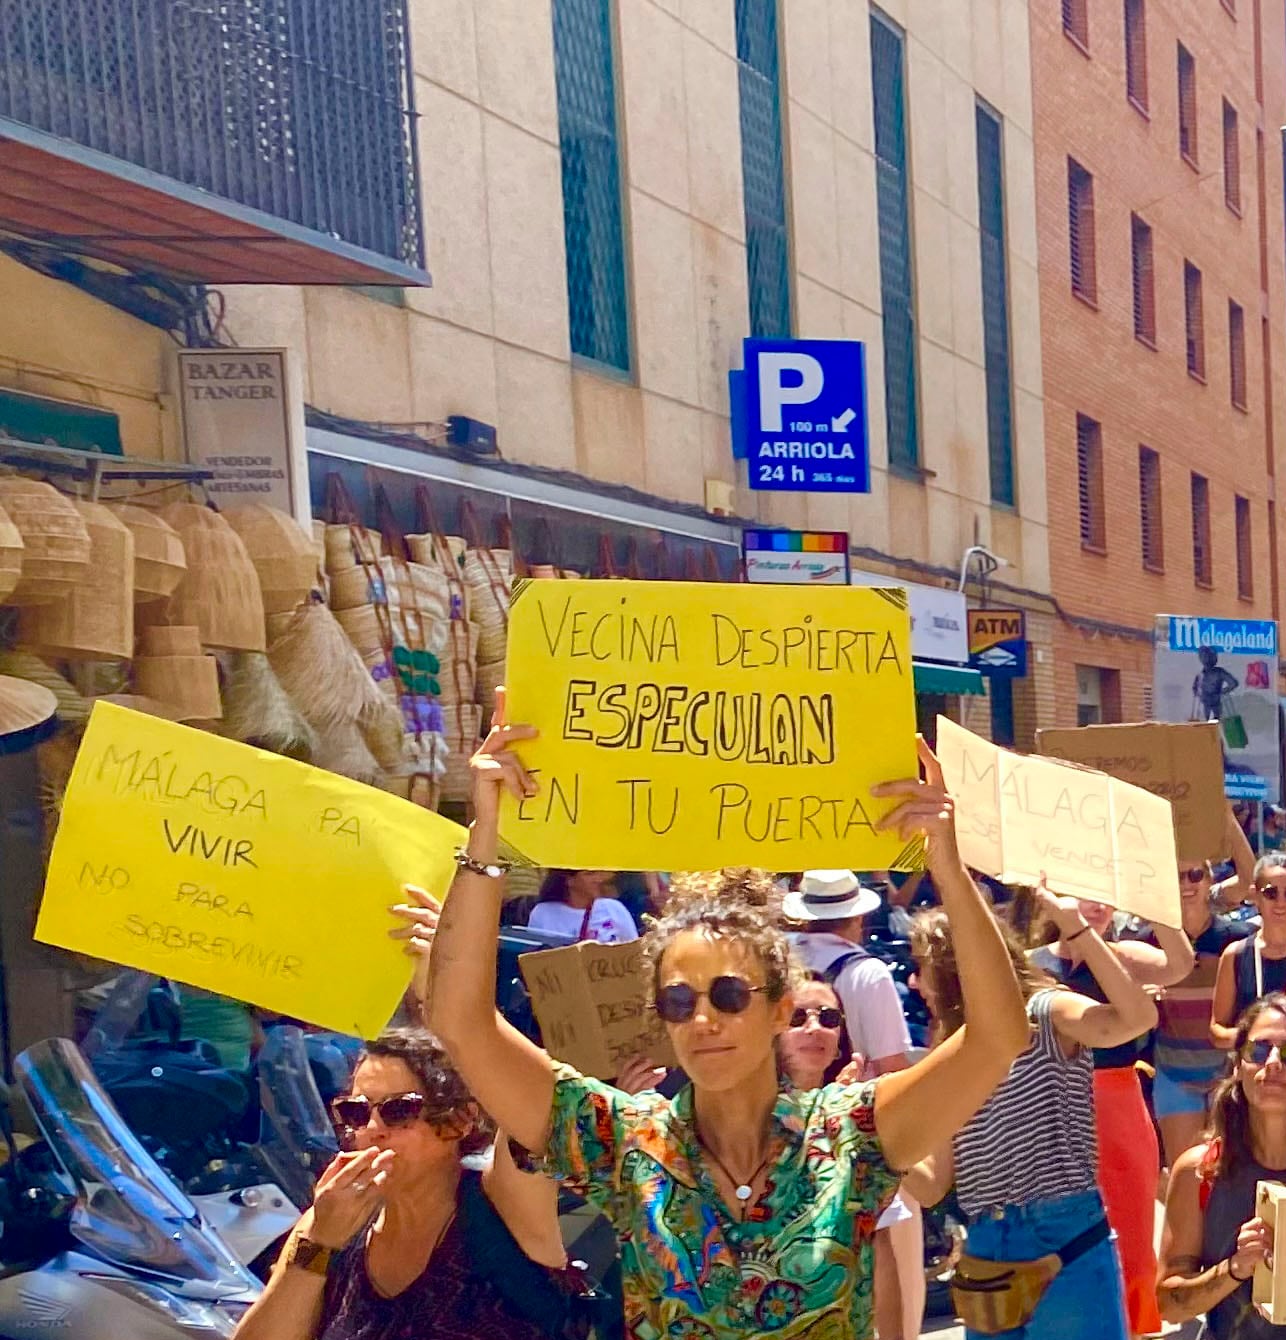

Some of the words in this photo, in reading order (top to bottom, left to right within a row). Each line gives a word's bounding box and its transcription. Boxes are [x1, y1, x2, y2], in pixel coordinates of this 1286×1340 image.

[187, 363, 275, 379] BAZAR
[188, 385, 277, 400] TANGER
[758, 351, 825, 433] P
[758, 441, 856, 459] ARRIOLA
[789, 421, 812, 433] 100
[815, 422, 829, 433] m
[759, 464, 785, 482] 24
[791, 464, 805, 482] h
[974, 617, 1020, 635] ATM
[562, 679, 835, 766] ESPECULAN
[95, 743, 269, 821] MÁLAGA
[518, 768, 580, 825] EN
[616, 778, 679, 836] TU
[709, 782, 879, 843] PUERTA
[961, 748, 1149, 849] MÁLAGA
[162, 818, 259, 869] VIVIR
[78, 860, 131, 895] NO
[175, 882, 255, 920] PARA
[123, 912, 305, 980] SOBREVIVIR
